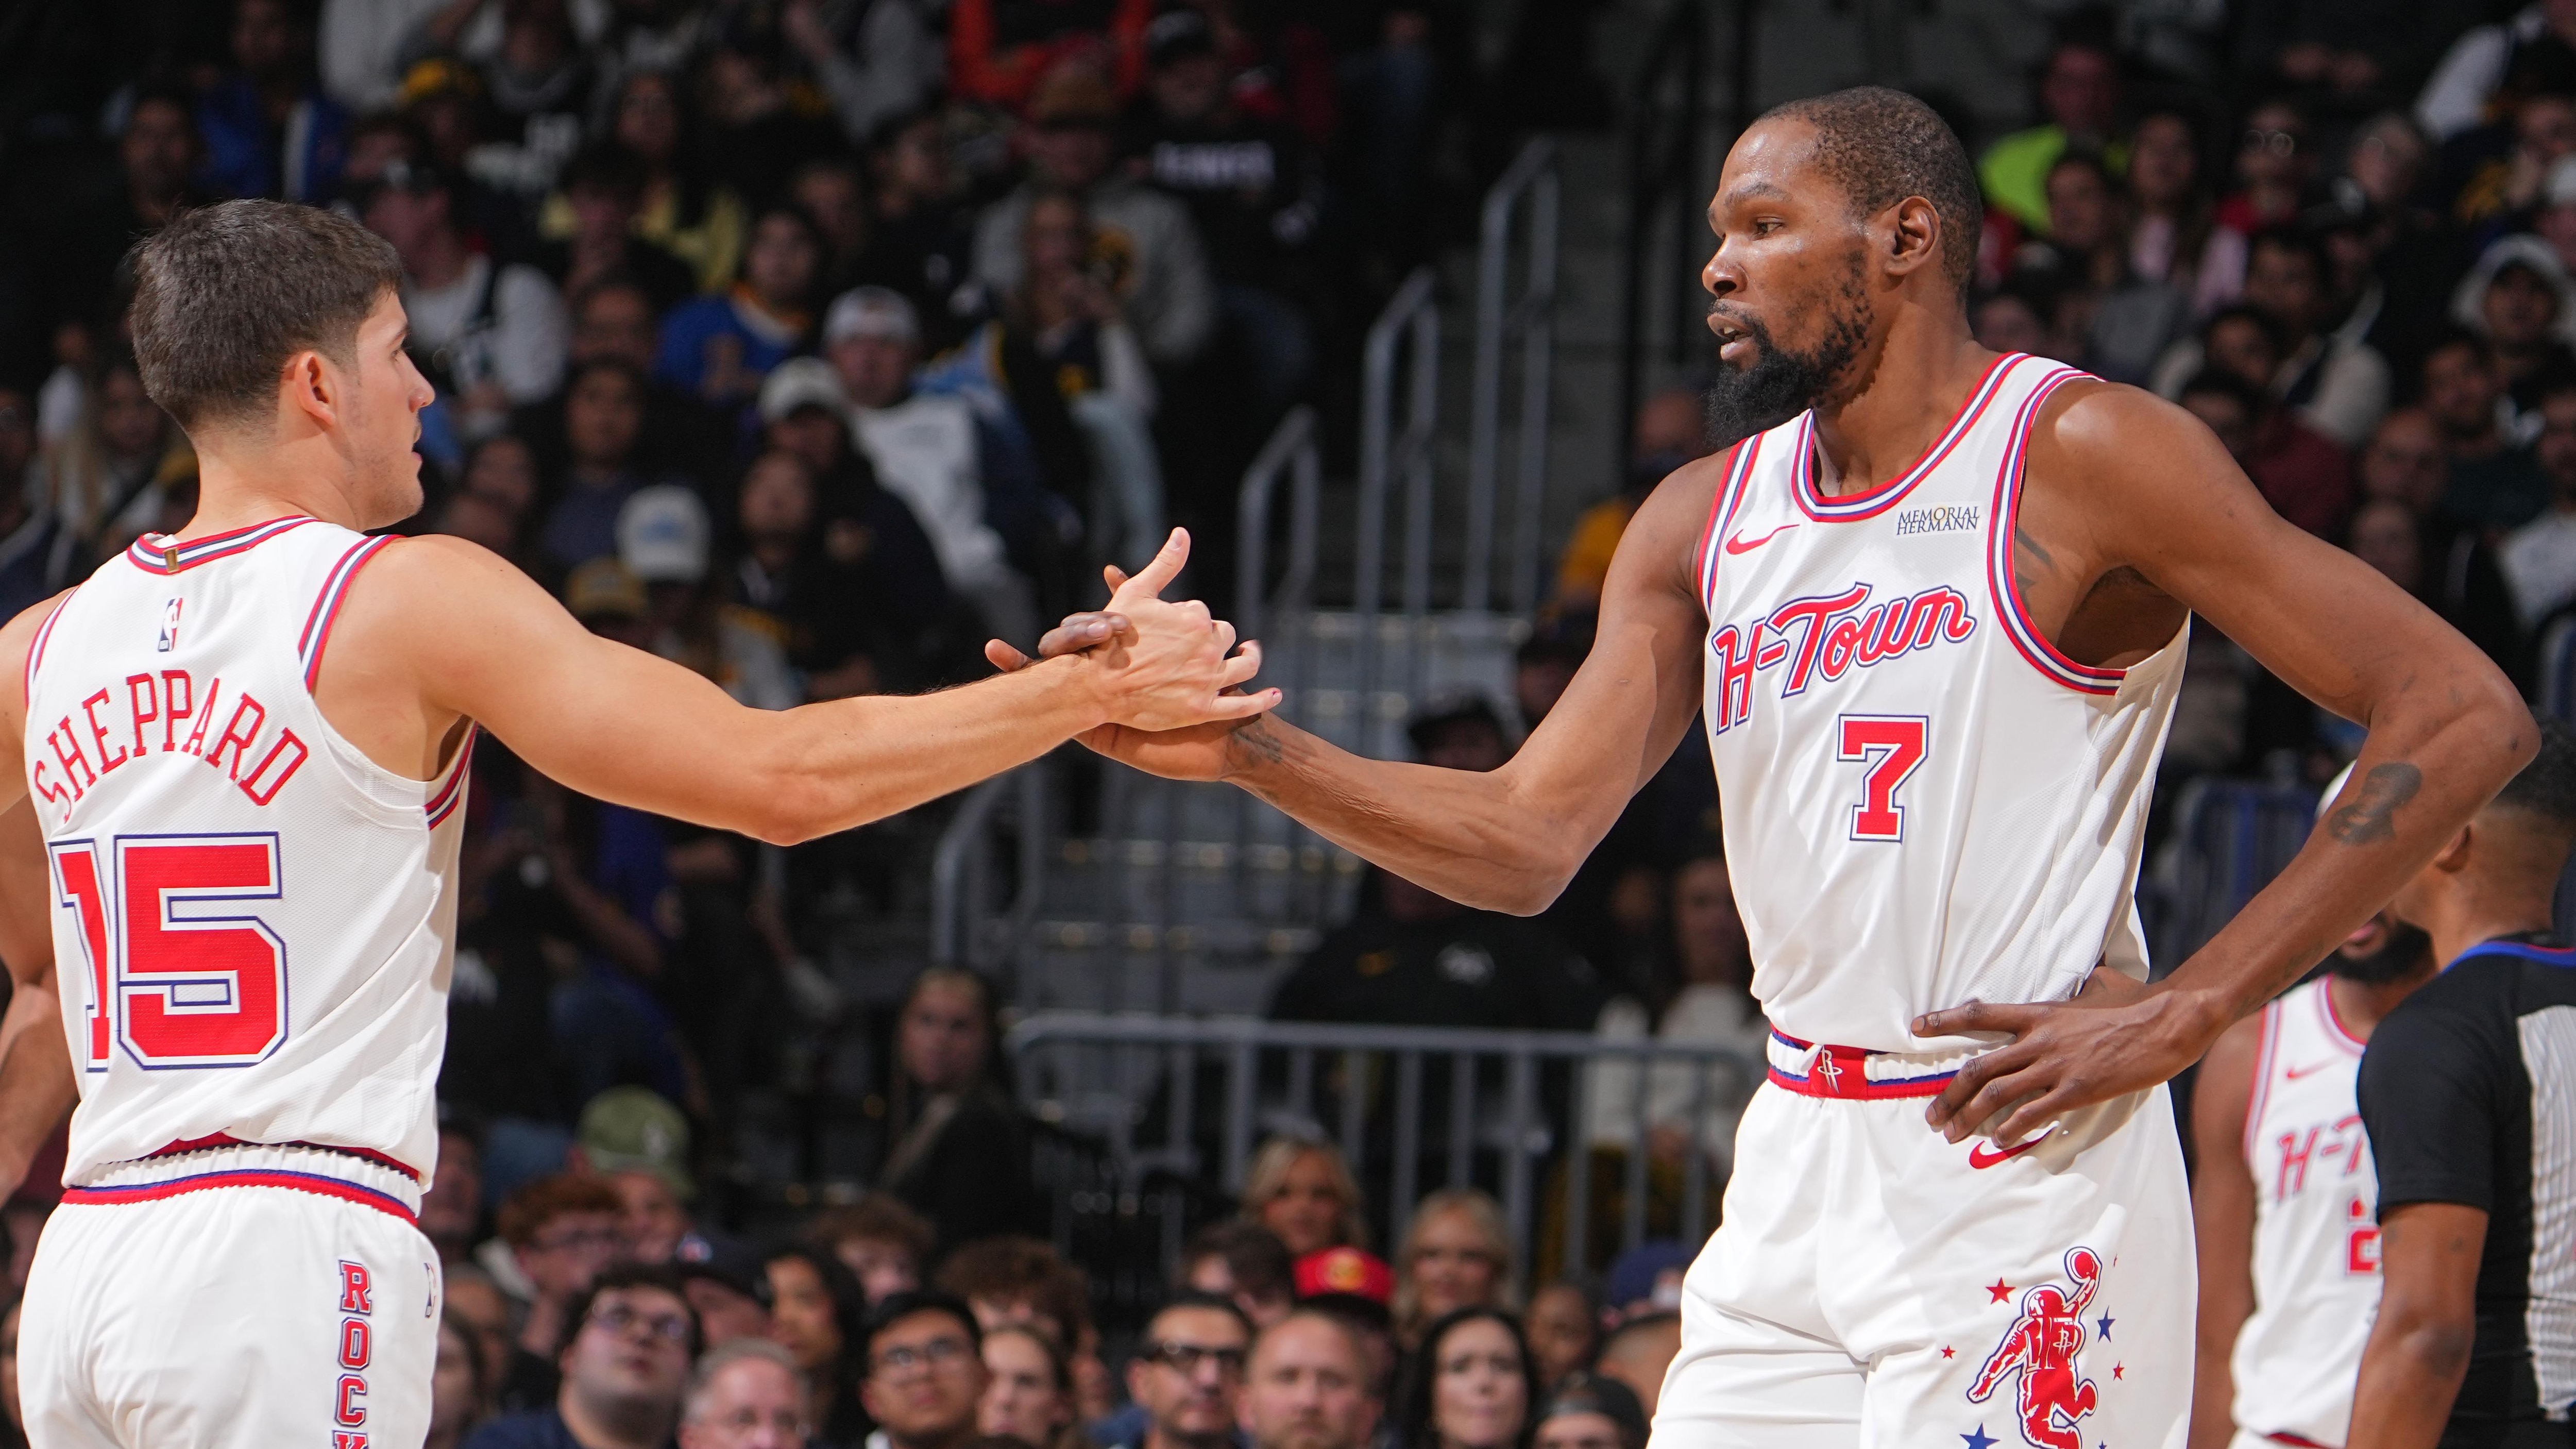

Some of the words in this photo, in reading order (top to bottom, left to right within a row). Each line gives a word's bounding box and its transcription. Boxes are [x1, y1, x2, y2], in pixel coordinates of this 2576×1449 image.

[1896, 517, 1978, 535] HERMANN
[1897, 506, 1980, 525] MEMORIAL
[1711, 582, 1976, 735] H-Town
[34, 669, 309, 823] SHEPPARD
[1837, 714, 1928, 844] 7
[49, 831, 289, 1073] 15
